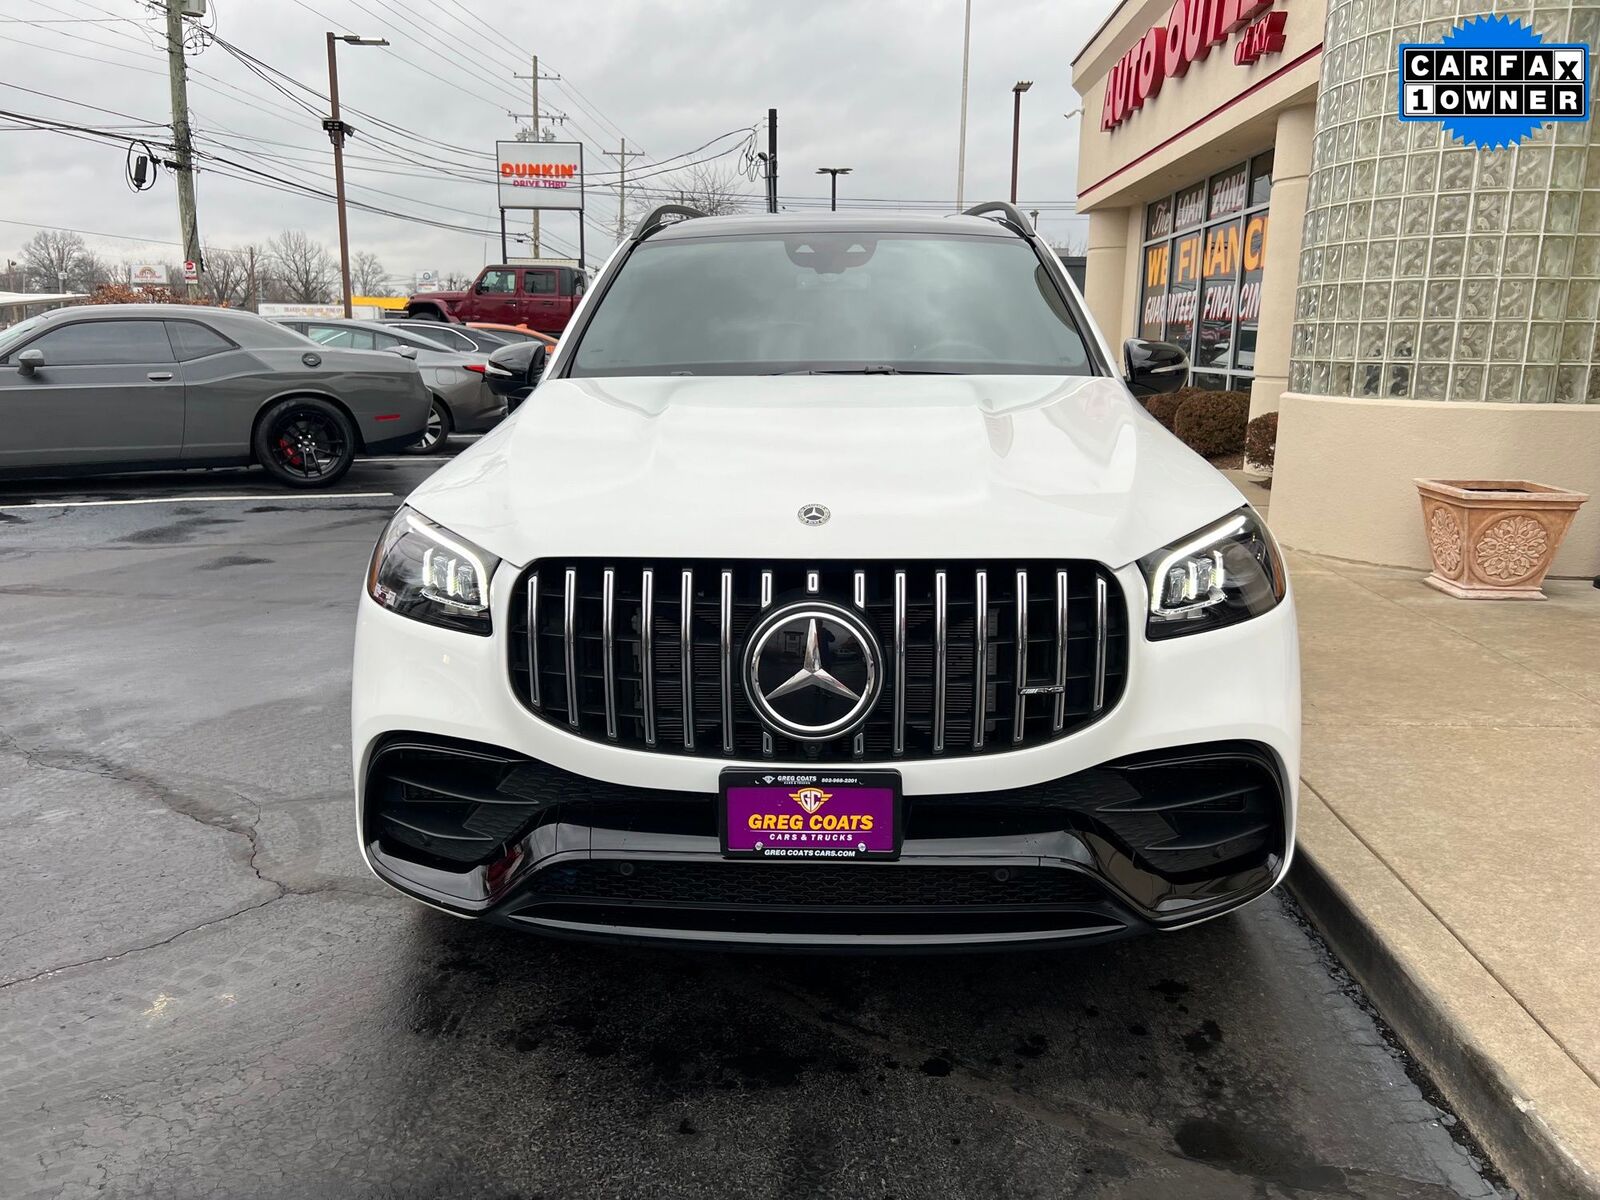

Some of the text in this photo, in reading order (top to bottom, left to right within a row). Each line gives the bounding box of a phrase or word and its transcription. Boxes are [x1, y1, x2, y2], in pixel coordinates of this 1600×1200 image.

[1101, 27, 1167, 132] AUTO
[501, 163, 577, 178] DUNKIN'
[542, 180, 567, 189] THRU
[1174, 188, 1207, 229] LOAN
[1211, 170, 1247, 217] ZONE
[1148, 246, 1169, 288] WE
[1203, 281, 1262, 319] FINANCIN
[748, 814, 874, 830] GREG COATS
